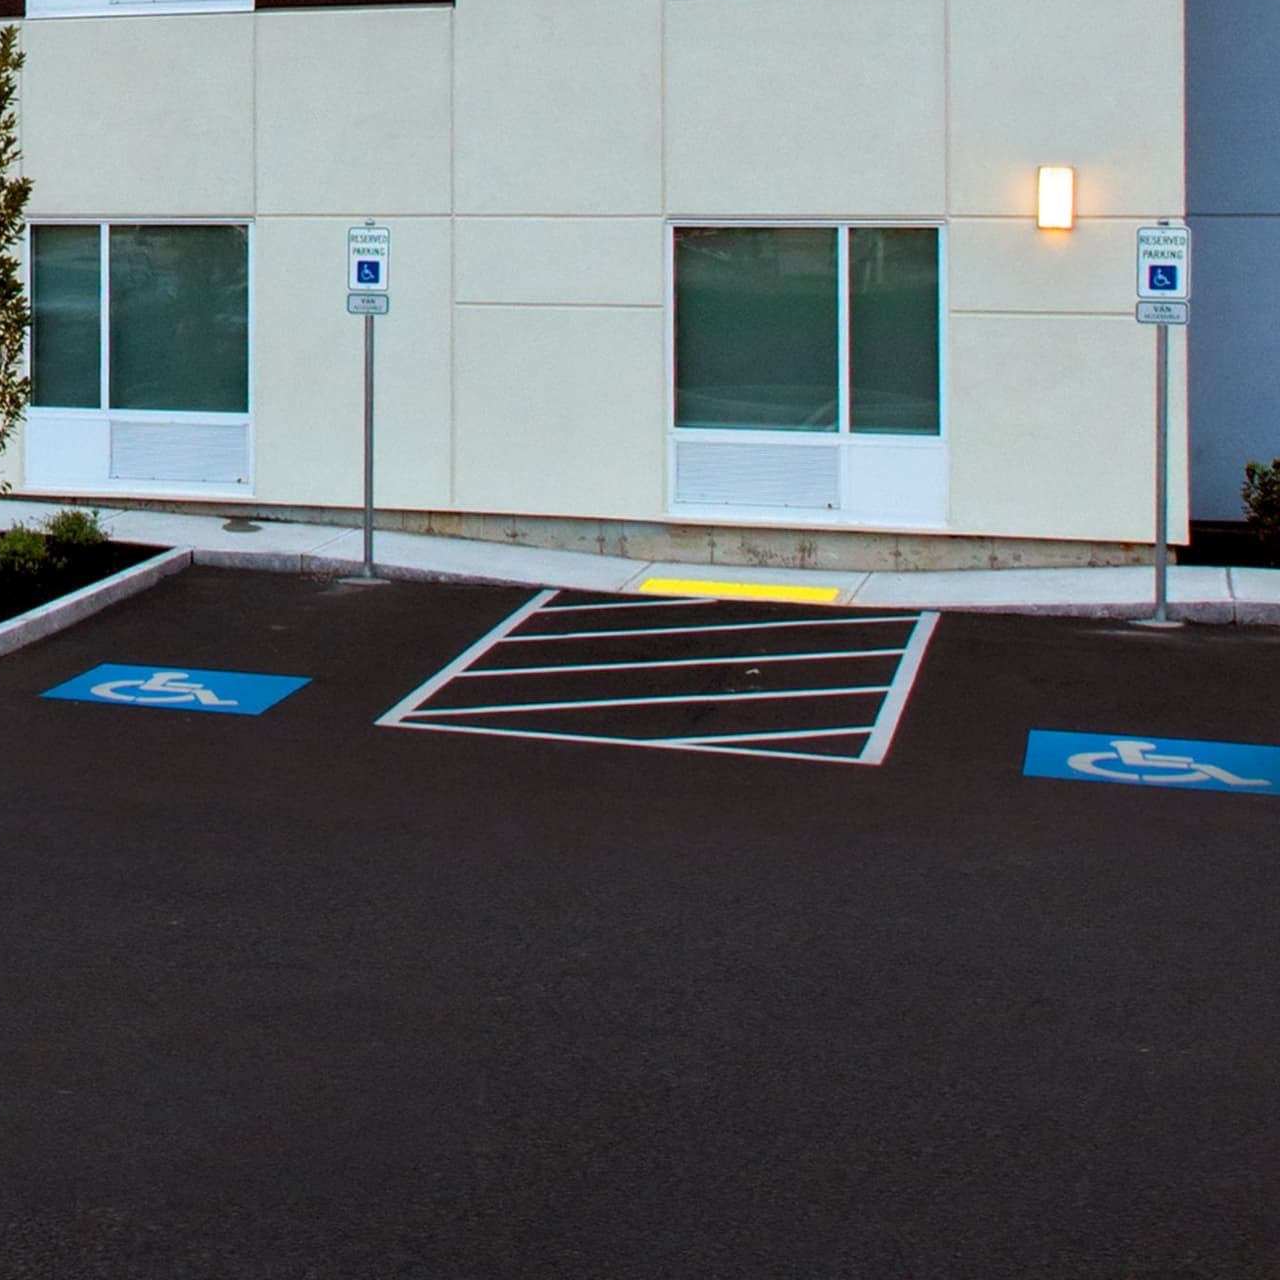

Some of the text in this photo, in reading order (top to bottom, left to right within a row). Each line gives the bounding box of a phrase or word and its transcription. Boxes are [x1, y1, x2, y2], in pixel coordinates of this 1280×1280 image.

[351, 234, 388, 243] RESERVED
[1140, 235, 1186, 245] RESERVED
[353, 247, 385, 256] PARKING
[1142, 249, 1183, 259] PARKING
[1153, 305, 1172, 313] VAN
